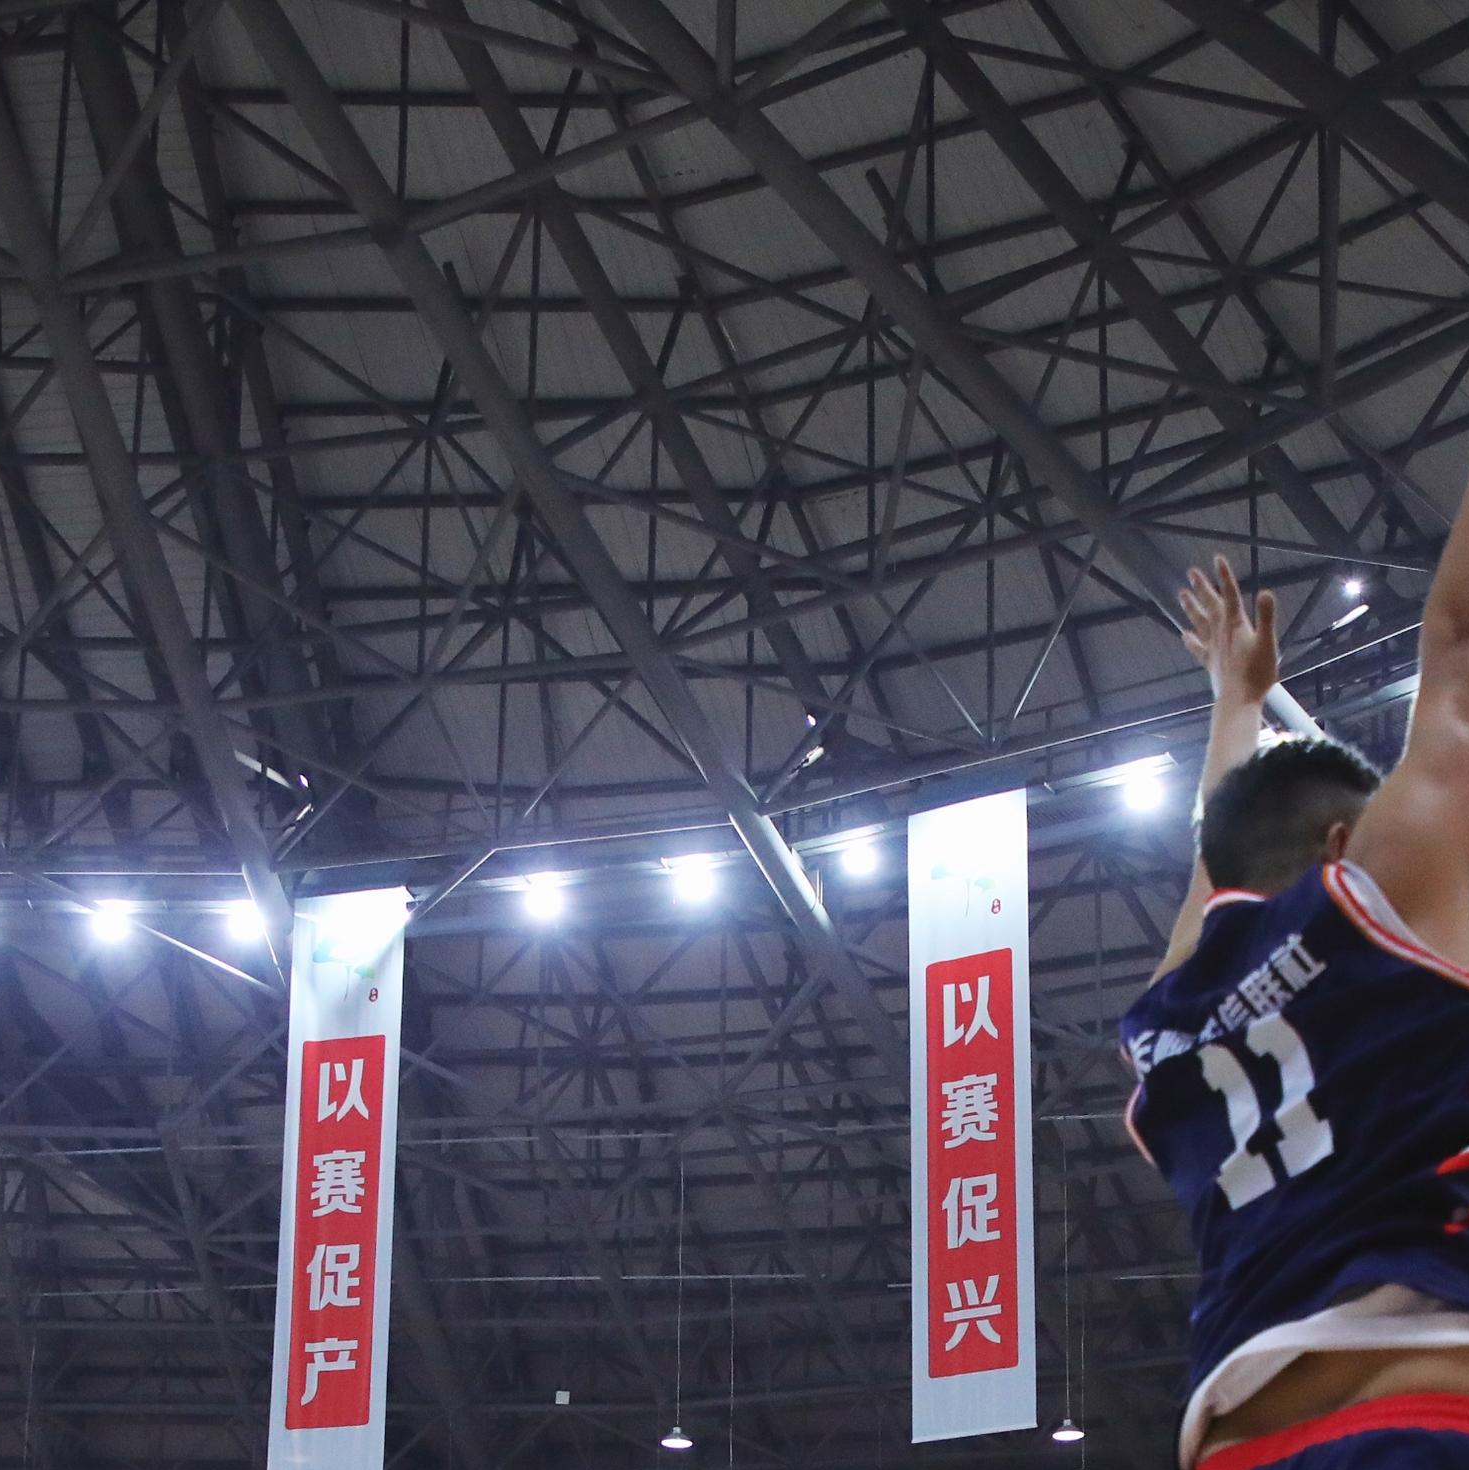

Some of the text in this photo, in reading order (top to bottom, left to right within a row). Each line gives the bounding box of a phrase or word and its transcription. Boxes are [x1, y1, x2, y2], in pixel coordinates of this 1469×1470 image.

[301, 1059, 369, 1406] 以赛促产
[941, 975, 1002, 1352] 以赛促兴
[1197, 1011, 1334, 1210] 11
